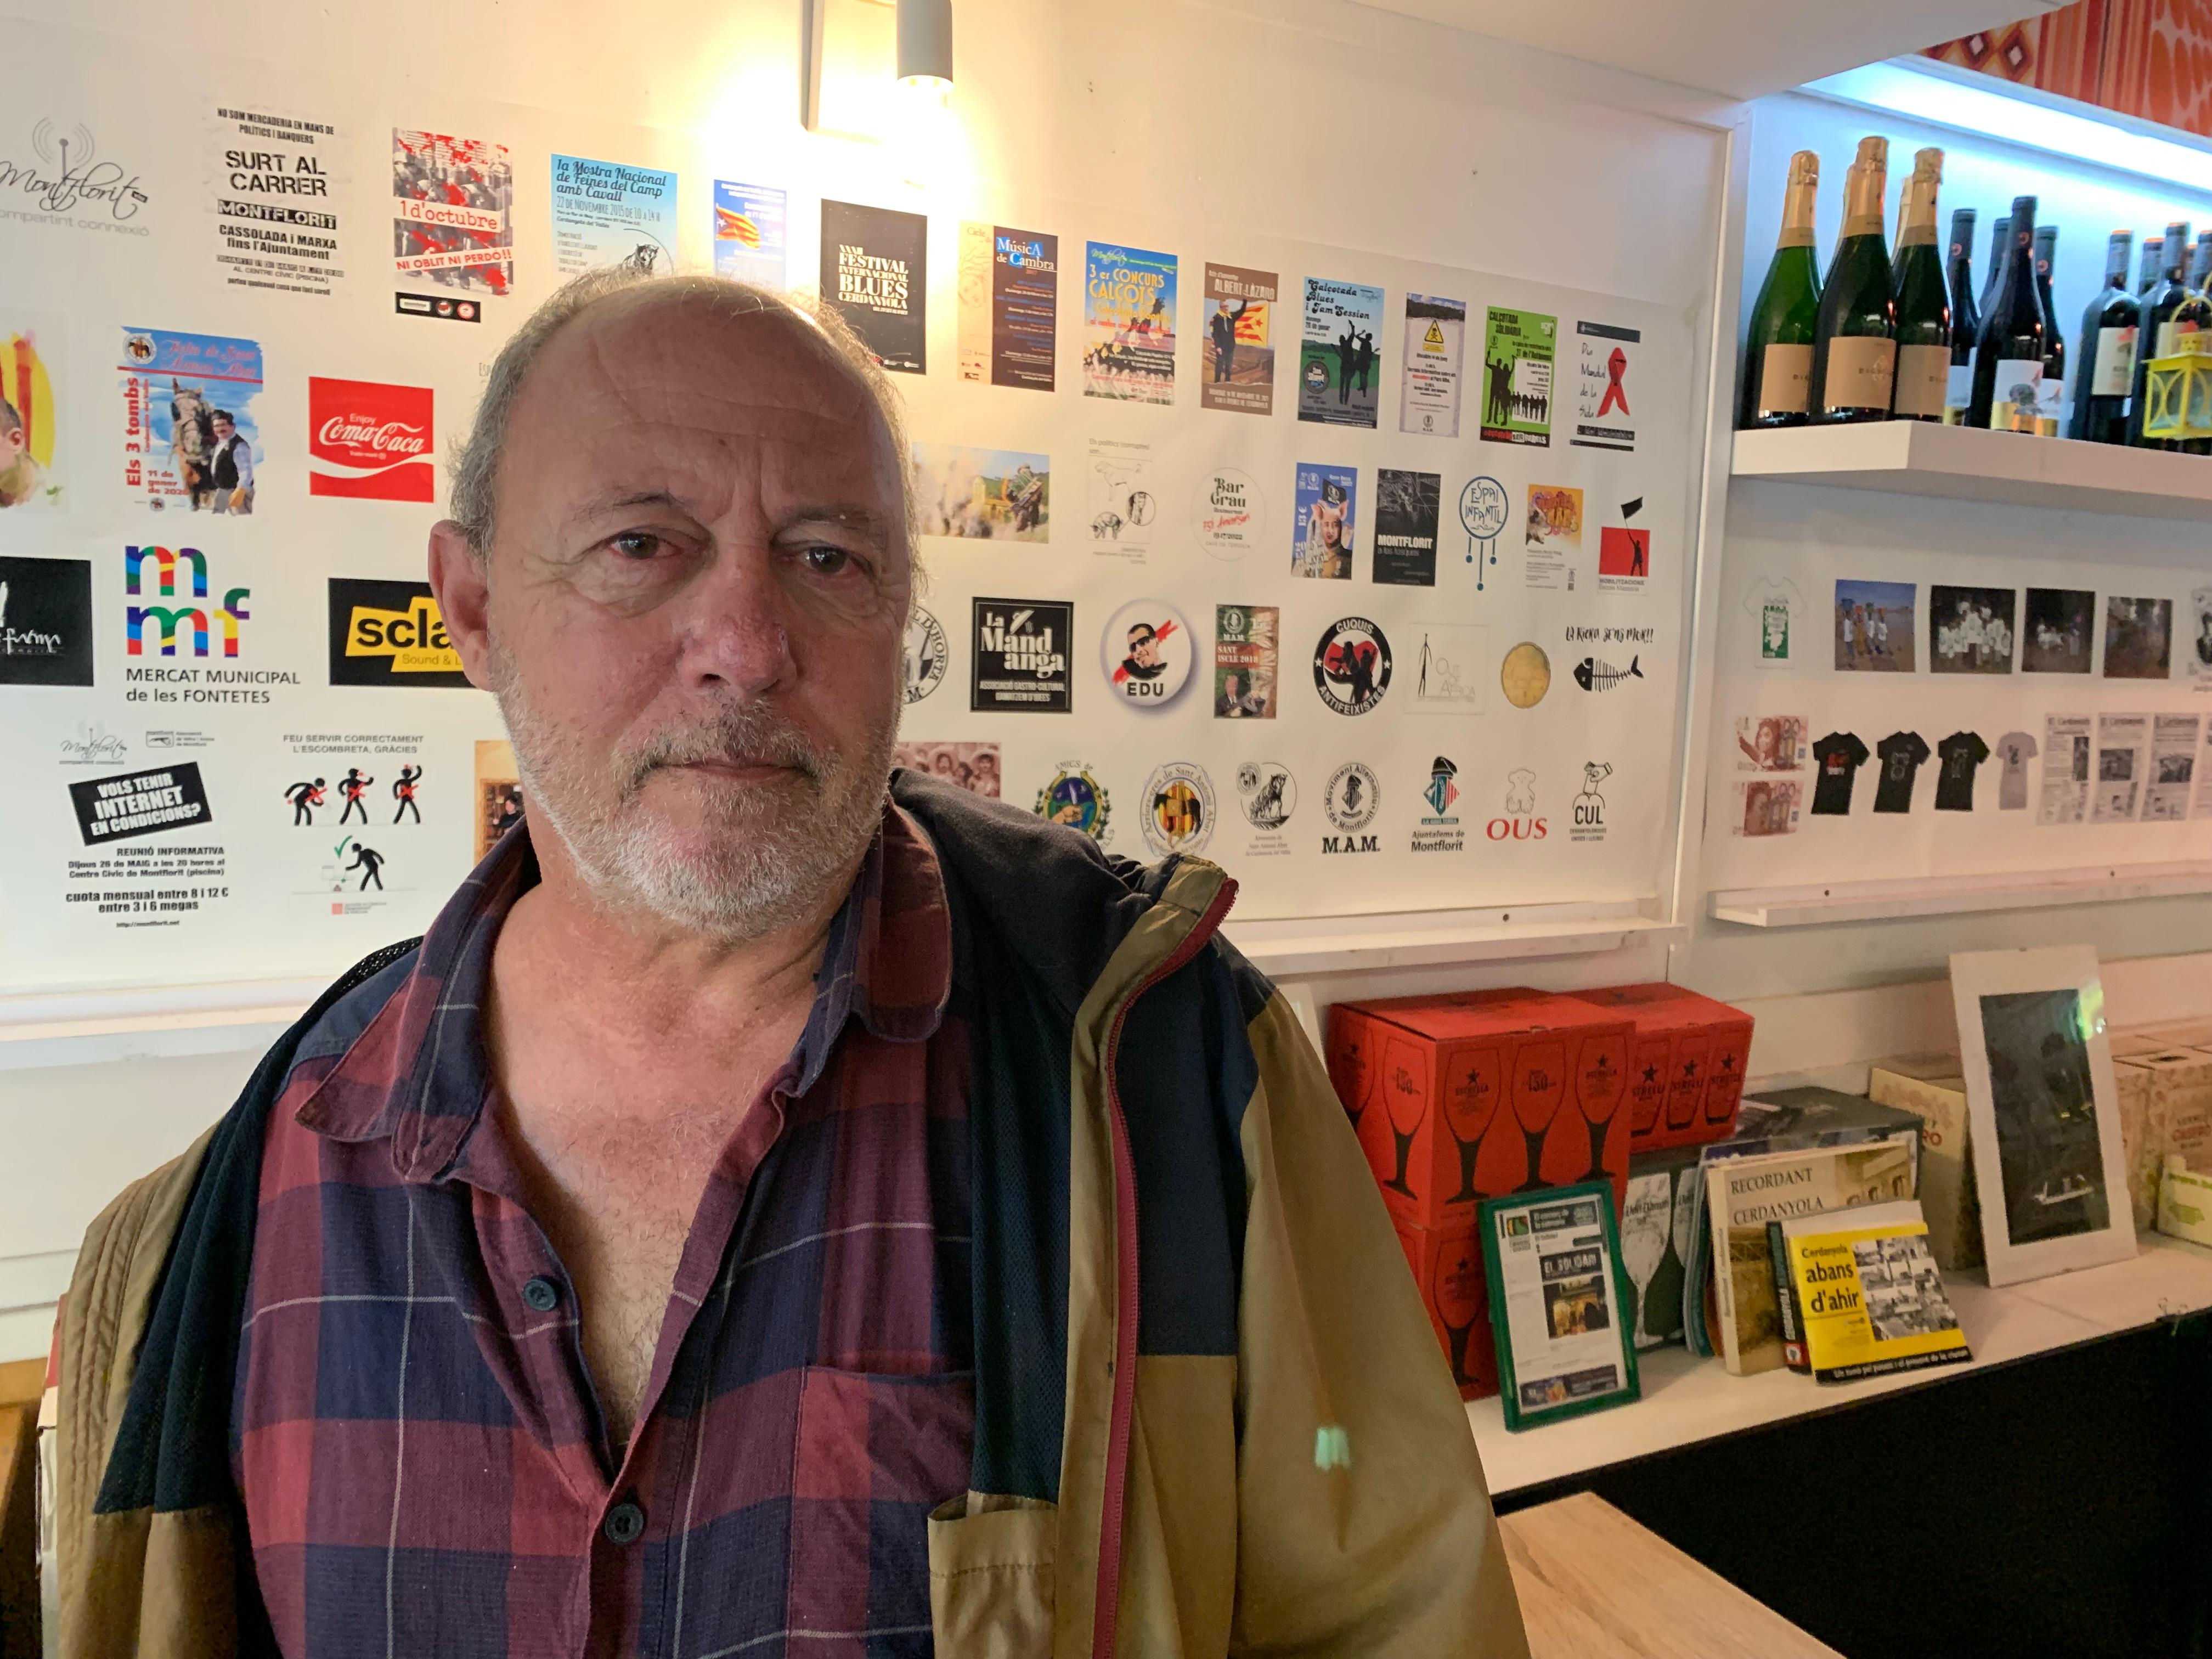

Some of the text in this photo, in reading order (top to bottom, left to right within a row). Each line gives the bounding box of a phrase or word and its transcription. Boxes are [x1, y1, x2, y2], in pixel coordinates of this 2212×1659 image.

[217, 108, 334, 135] NO SOM MERCADERIA EN MANS DE
[239, 124, 314, 144] POLÍTICS BANQUERS
[225, 150, 327, 175] SURT AL
[572, 161, 612, 178] Mostra
[614, 167, 667, 187] Nacional
[0, 161, 139, 220] Montflorit
[229, 172, 328, 197] CARRER
[556, 171, 663, 199] de Feines del Camp
[556, 184, 622, 202] amb Cavall
[219, 200, 335, 228] MONTFLORIT
[400, 200, 497, 229] 1 d'octubre
[557, 196, 564, 208] 22
[566, 199, 573, 210] DE
[576, 198, 609, 216] NOVEMBRE
[625, 206, 633, 219] DE
[78, 219, 149, 237] connexió
[219, 224, 337, 250] CASSOLADA i MARXA
[227, 238, 330, 260] fins l'Ajuntament
[397, 260, 410, 270] NI
[414, 257, 445, 269] OBLIT
[448, 255, 461, 267] NI
[839, 252, 909, 274] FESTIVAL
[997, 252, 1054, 270] de Cambra
[245, 267, 273, 276] CENTRE
[838, 265, 909, 283] INTERNACIONAL
[1090, 264, 1165, 289] 3 er CONCURS
[839, 274, 908, 300] BLUES
[1089, 279, 1156, 306] CALÇOTS
[1214, 278, 1243, 296] ALBERT
[1308, 279, 1357, 296] Calçotada
[838, 291, 908, 309] CERDANYOLA
[1306, 291, 1335, 304] Blues
[1311, 302, 1370, 320] Jam Session
[349, 413, 377, 425] Enjoy
[124, 377, 141, 486] Els 3 tombs
[161, 470, 174, 478] de
[1214, 477, 1244, 494] Bar
[1471, 482, 1499, 505] ESPAI
[1210, 489, 1246, 508] Grau
[1465, 504, 1502, 525] INFANTIL
[1378, 534, 1433, 549] MONTFLORIT
[1599, 578, 1645, 586] MOBILITZACIONS
[986, 612, 1005, 628] La
[1336, 618, 1374, 635] CUQUIS
[980, 626, 1053, 654] Mand
[1218, 645, 1237, 654] SANT
[1218, 654, 1238, 663] ISCLE
[402, 653, 451, 665] Sound &
[126, 668, 301, 685] MERCAT MUNICIPAL
[126, 687, 270, 703] de les FONTETES
[1126, 682, 1164, 697] EDU
[1318, 685, 1386, 715] ANTIFEIXISTES
[284, 735, 424, 744] FEU SERVIR CORRECTAMENT
[293, 744, 417, 754] L'ESCOMBRETA, GRÀCIES
[1054, 760, 1093, 771] AMICS de
[1175, 766, 1194, 778] Sant
[97, 772, 174, 799] VOLS TENIR
[94, 785, 183, 820] INTERNET
[90, 802, 201, 836] EN CONDICIONS?
[1338, 809, 1374, 832] Montflorit
[1575, 805, 1604, 825] CUL
[1455, 830, 1465, 838] de
[1486, 817, 1548, 841] OUS
[117, 846, 224, 856] REUNIÓ INFORMATIVA
[1322, 836, 1381, 854] M.A.M.
[1411, 839, 1463, 853] Montflorit
[68, 861, 97, 869] Dijous
[69, 870, 99, 878] Centre
[102, 869, 124, 877] Cívic
[140, 868, 184, 877] Montflorit
[187, 868, 224, 877] (piscina)
[66, 887, 229, 902] cuota mensual entre 8 i 12 €
[98, 900, 199, 913] entre 3 6 megas
[1730, 1166, 1814, 1195] RECORDANT
[1733, 1195, 1825, 1227] CERDANYOLA
[1802, 1243, 1849, 1259] Cerdanyola
[1806, 1261, 1854, 1284] abans
[1811, 1287, 1860, 1313] d'ahir
